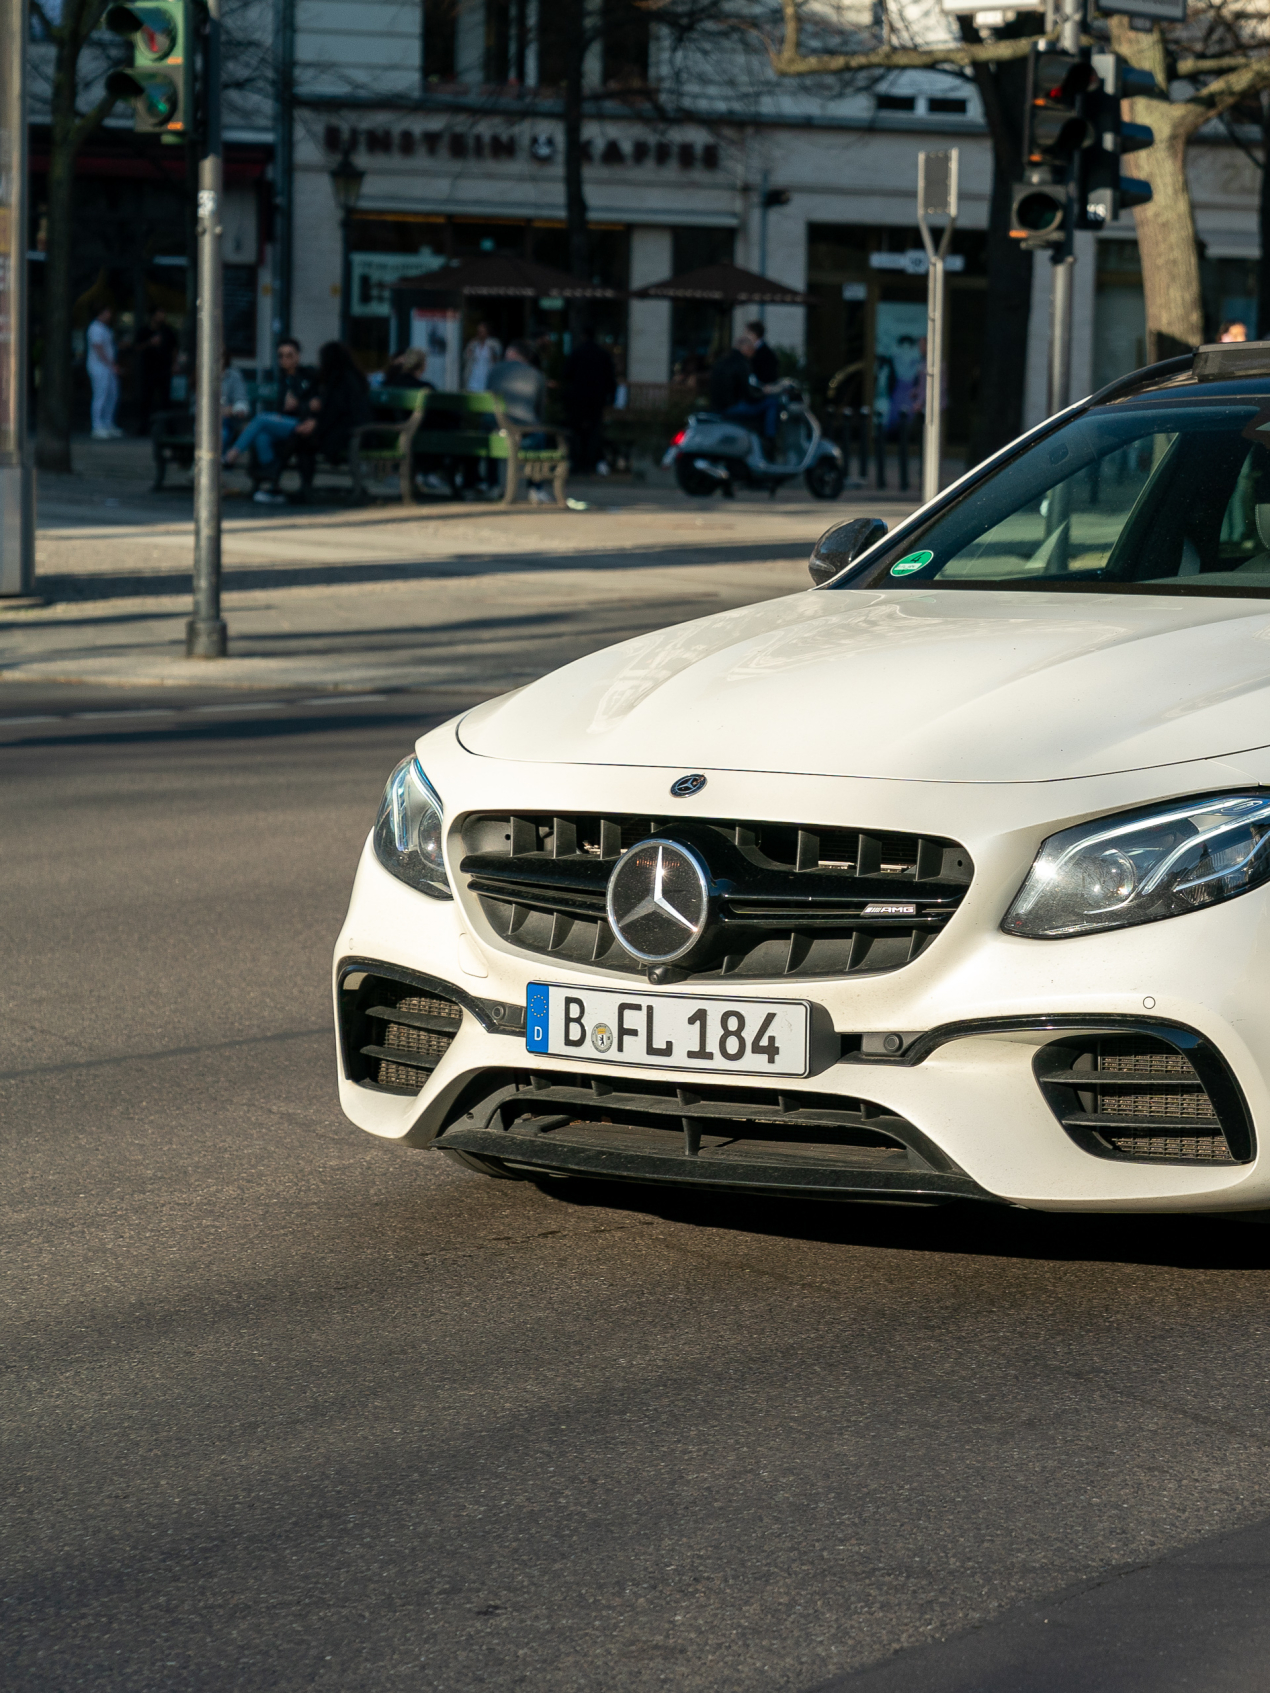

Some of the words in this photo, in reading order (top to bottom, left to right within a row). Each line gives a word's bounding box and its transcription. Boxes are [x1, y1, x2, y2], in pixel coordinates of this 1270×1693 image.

[325, 125, 516, 159] EINSTEIN
[534, 1026, 543, 1041] D
[564, 996, 587, 1047] B
[617, 1002, 674, 1057] FL
[686, 1008, 780, 1064] 184
